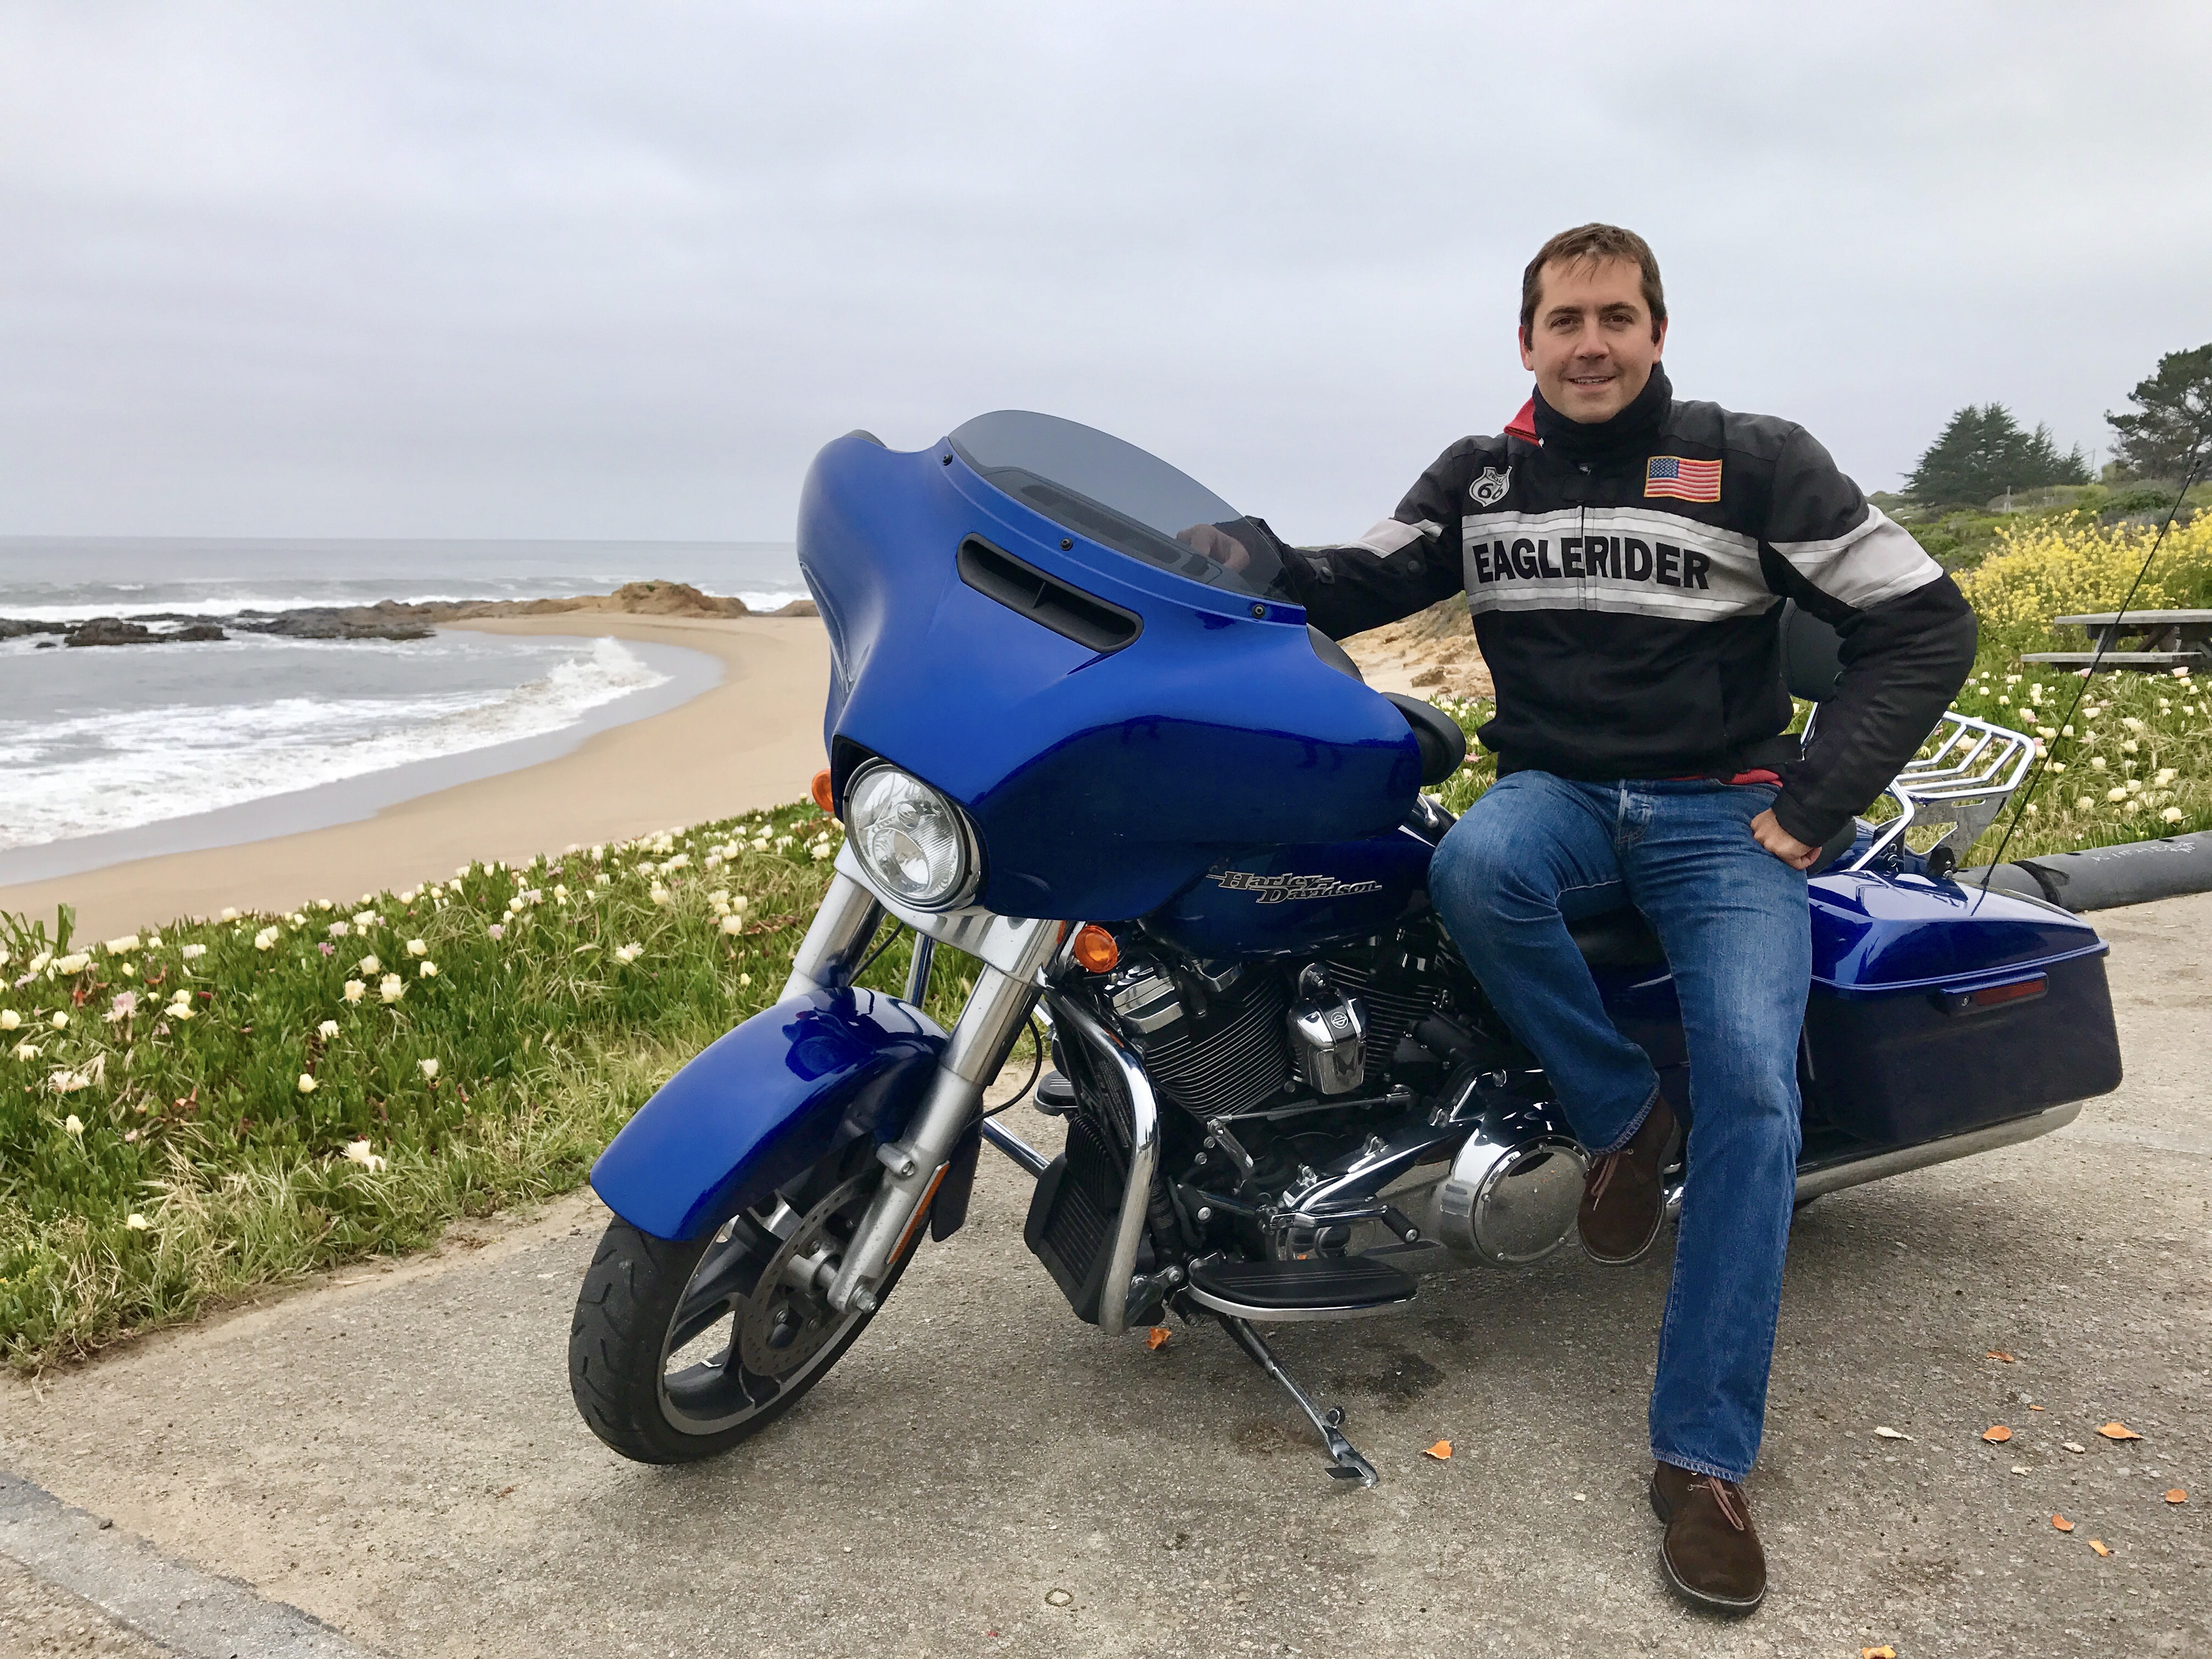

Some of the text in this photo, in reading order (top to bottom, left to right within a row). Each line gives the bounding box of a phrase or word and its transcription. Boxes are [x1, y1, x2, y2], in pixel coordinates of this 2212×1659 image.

[1477, 483, 1503, 500] 66
[1472, 536, 1710, 590] EAGLERIDER
[1250, 881, 1382, 903] Davidson
